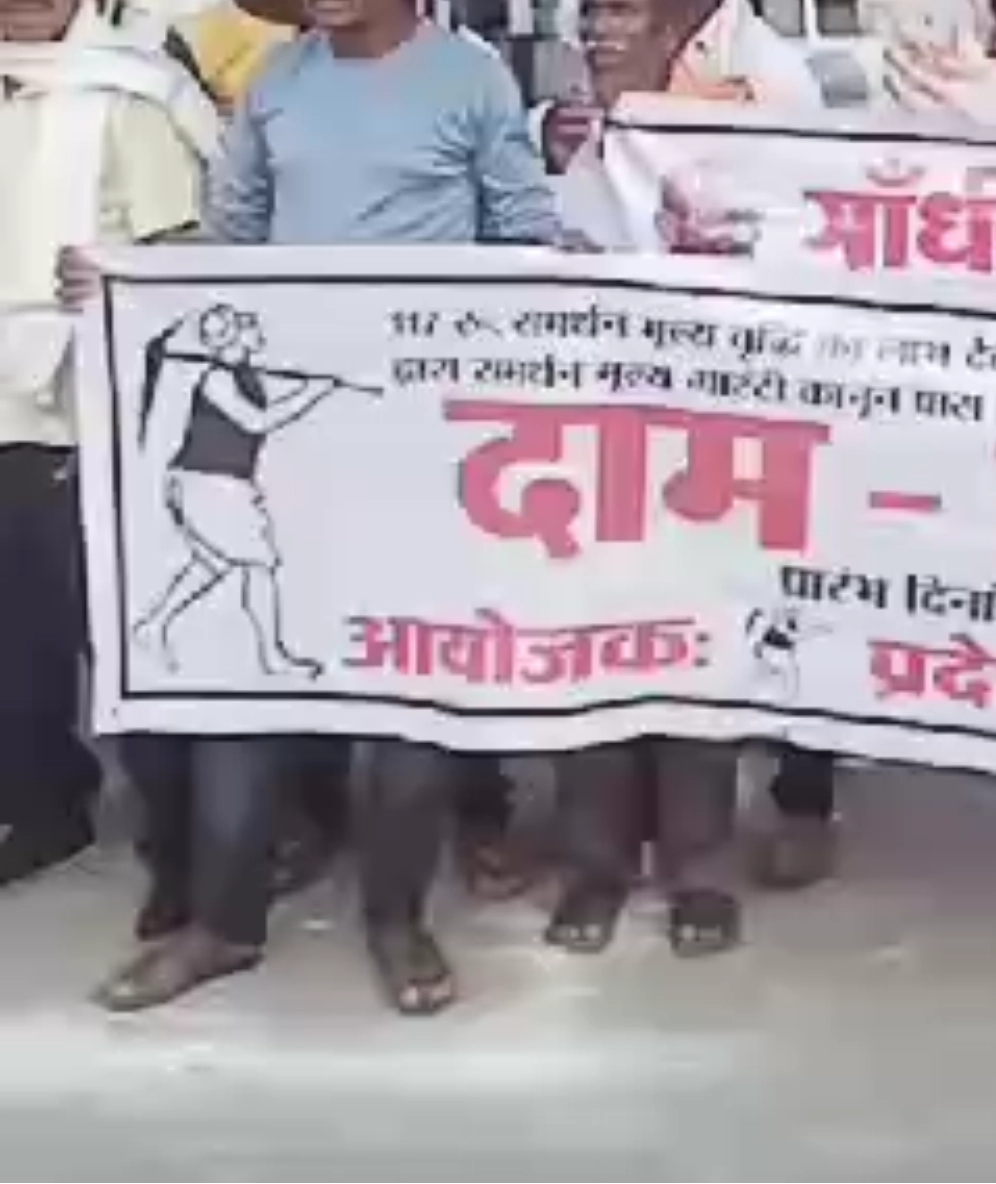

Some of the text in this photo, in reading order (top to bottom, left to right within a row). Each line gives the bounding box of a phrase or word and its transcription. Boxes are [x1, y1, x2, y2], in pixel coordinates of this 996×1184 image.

[513, 304, 629, 338] समर्थन
[473, 354, 582, 390] समर्थन
[444, 398, 832, 561] दाम
